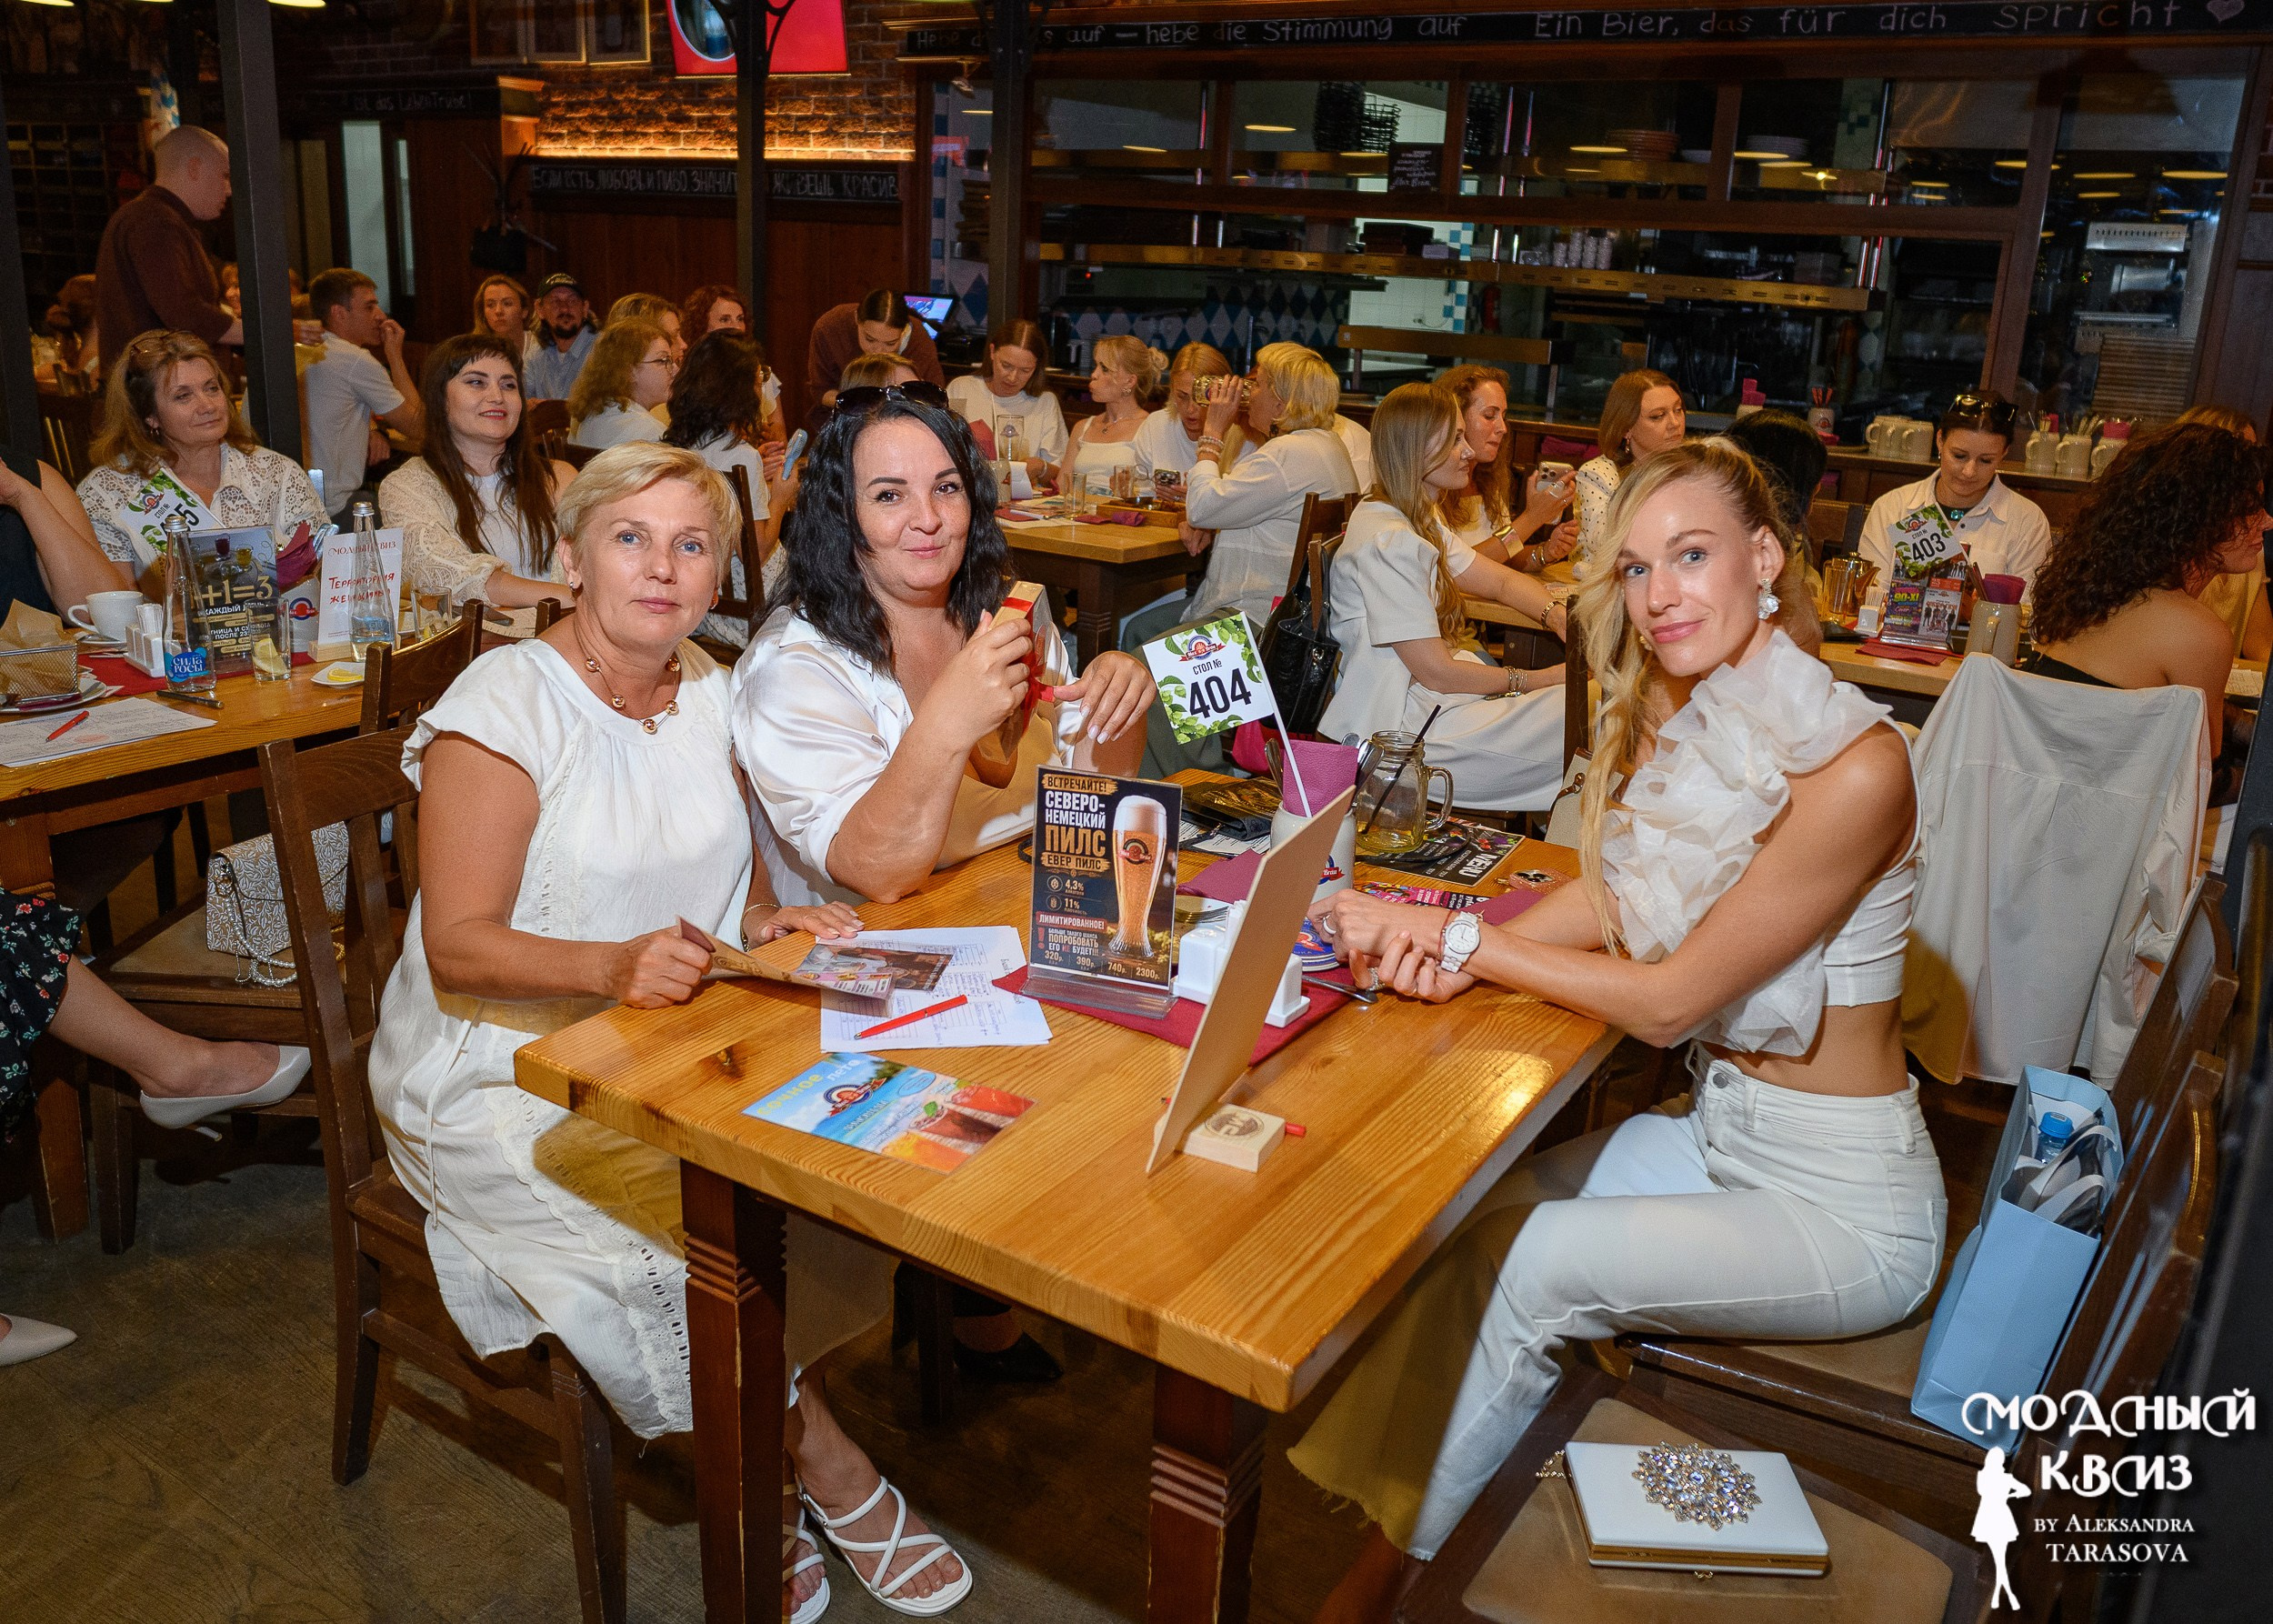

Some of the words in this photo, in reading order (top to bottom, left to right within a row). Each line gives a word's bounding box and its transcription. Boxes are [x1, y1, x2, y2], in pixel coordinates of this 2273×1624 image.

[1145, 23, 1199, 45] hebe
[1213, 23, 1247, 42] die
[1262, 17, 1394, 42] Stimmung
[1417, 15, 1468, 37] auf
[1534, 13, 1583, 38] Ein
[1601, 11, 1680, 37] Bier,
[1698, 11, 1755, 34] das
[1778, 7, 1847, 35] für
[1878, 5, 1948, 31] dich
[1911, 533, 1947, 562] 403
[1192, 661, 1214, 676] СТОЛ
[1189, 667, 1252, 719] 404
[1047, 776, 1107, 792] ВСТРЕЧАЙТЕ!
[1045, 789, 1106, 812] СЕВЕРО-
[1045, 808, 1106, 829] НЕМЕЦКИЙ
[1045, 824, 1106, 857] ПИЛС
[1047, 854, 1072, 867] ЕВЕР
[1076, 856, 1101, 870] ПИЛС
[1064, 897, 1080, 909] 11%
[1039, 913, 1105, 930] ЛИМИТИРОВАННОЕ!
[1048, 933, 1099, 948] ПОПРОБОВАТЬ
[1048, 942, 1060, 952] ЕГО
[826, 1058, 861, 1082] лето
[756, 1074, 824, 1116] сочное
